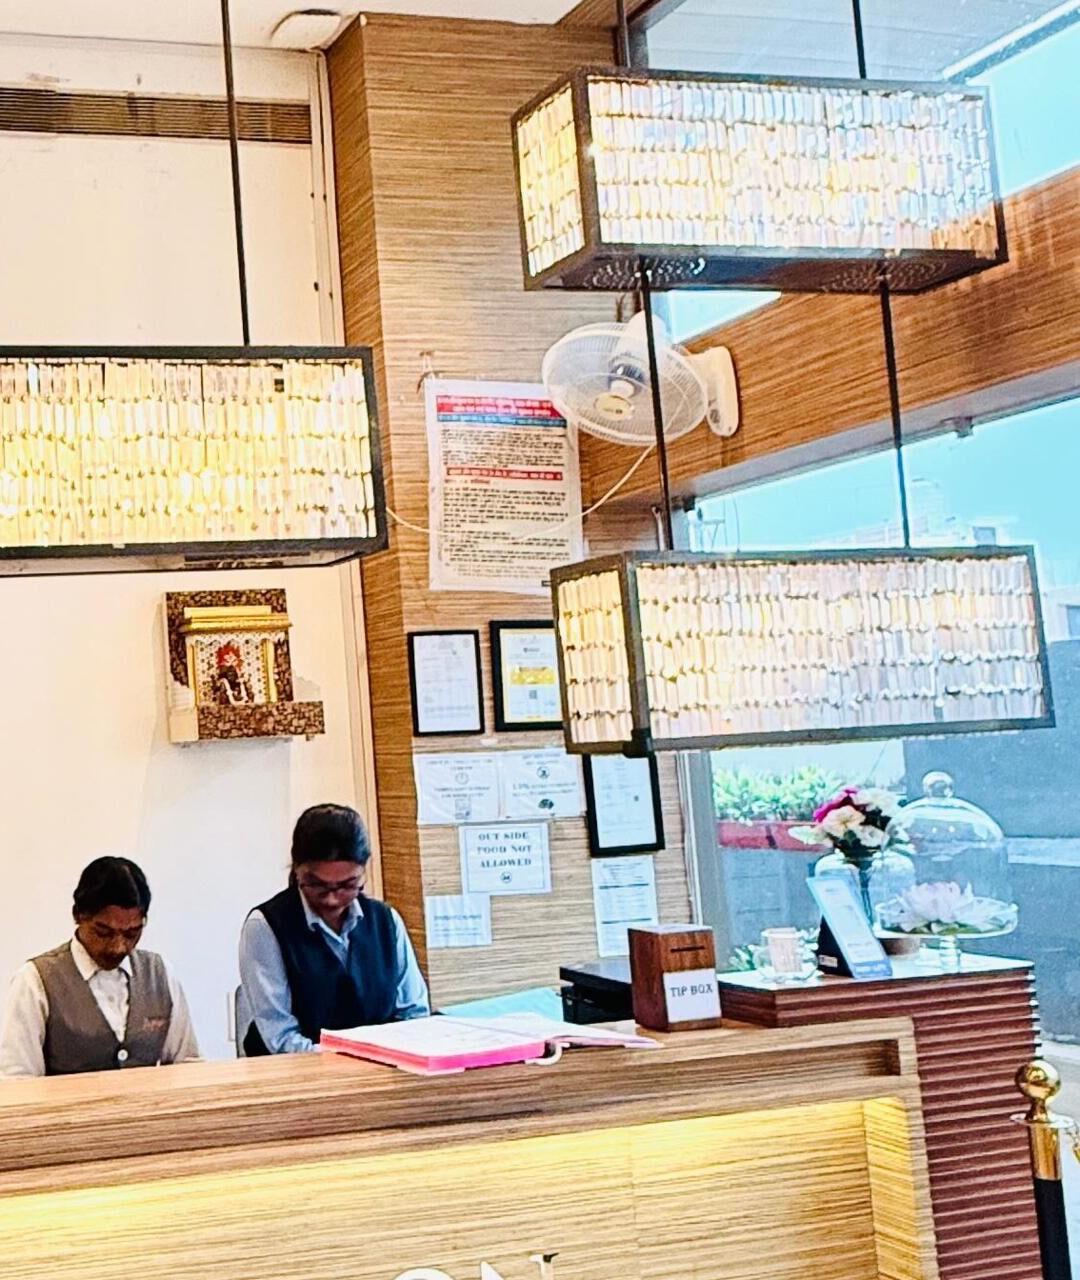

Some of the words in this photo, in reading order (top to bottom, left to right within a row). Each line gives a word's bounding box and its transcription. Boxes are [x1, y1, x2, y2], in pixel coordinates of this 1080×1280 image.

[478, 833, 500, 841] OUT
[504, 831, 529, 840] SIDE
[477, 846, 507, 854] FOOD
[511, 845, 532, 853] NOT
[480, 858, 532, 868] ALLOWED
[670, 985, 687, 997] TIP
[690, 983, 713, 995] BOX
